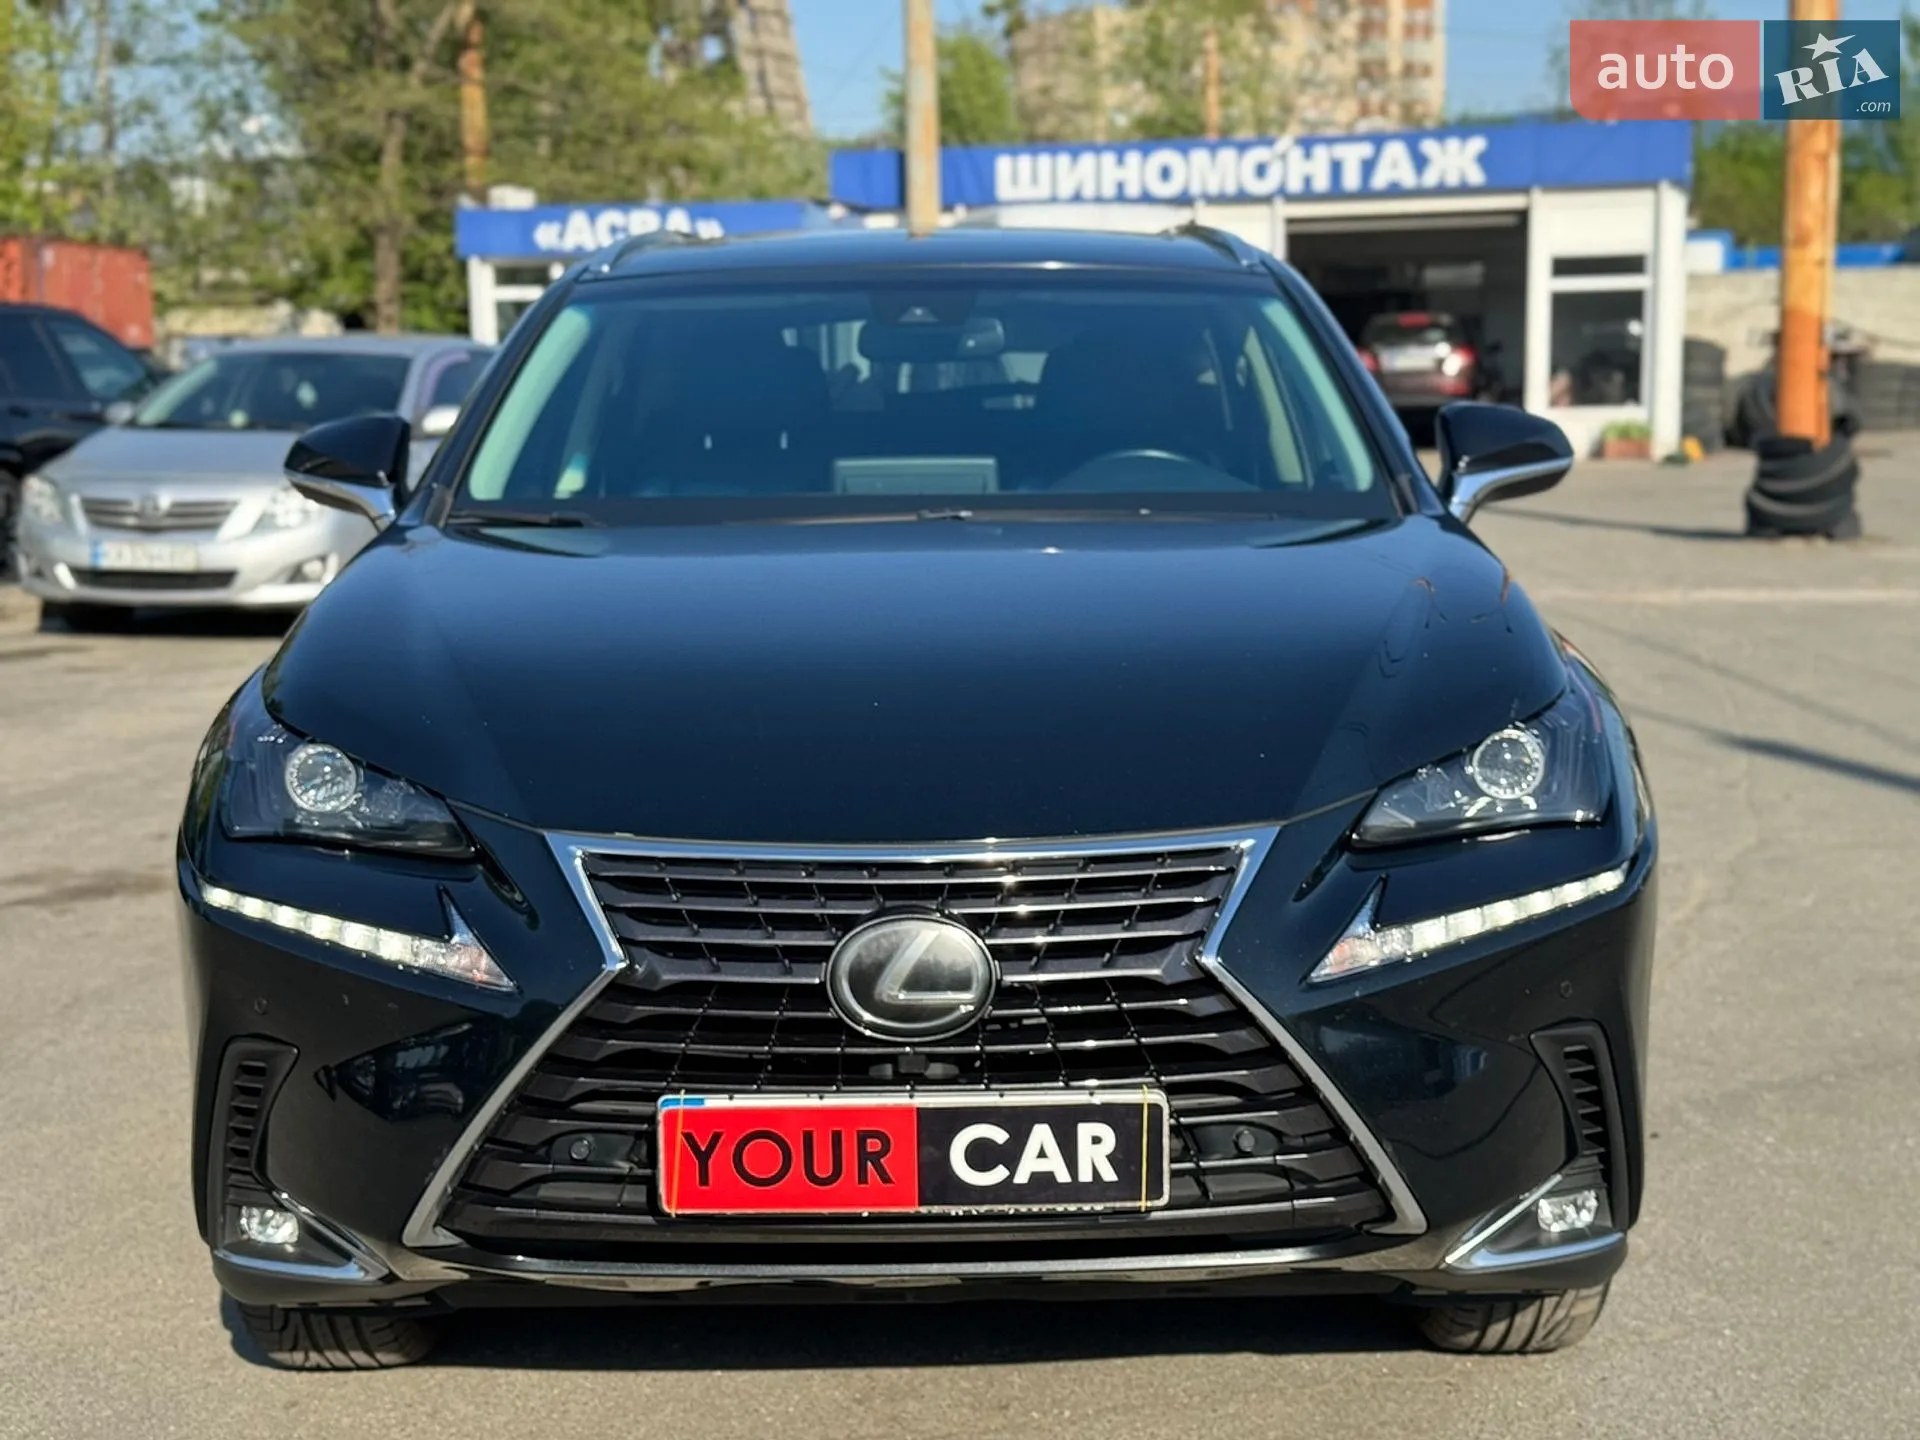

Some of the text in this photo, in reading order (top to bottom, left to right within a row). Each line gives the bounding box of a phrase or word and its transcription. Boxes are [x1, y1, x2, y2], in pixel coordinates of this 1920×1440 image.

[994, 135, 1488, 202] ШИНОМОНТАЖ
[681, 1121, 1120, 1188] YOUR CAR
